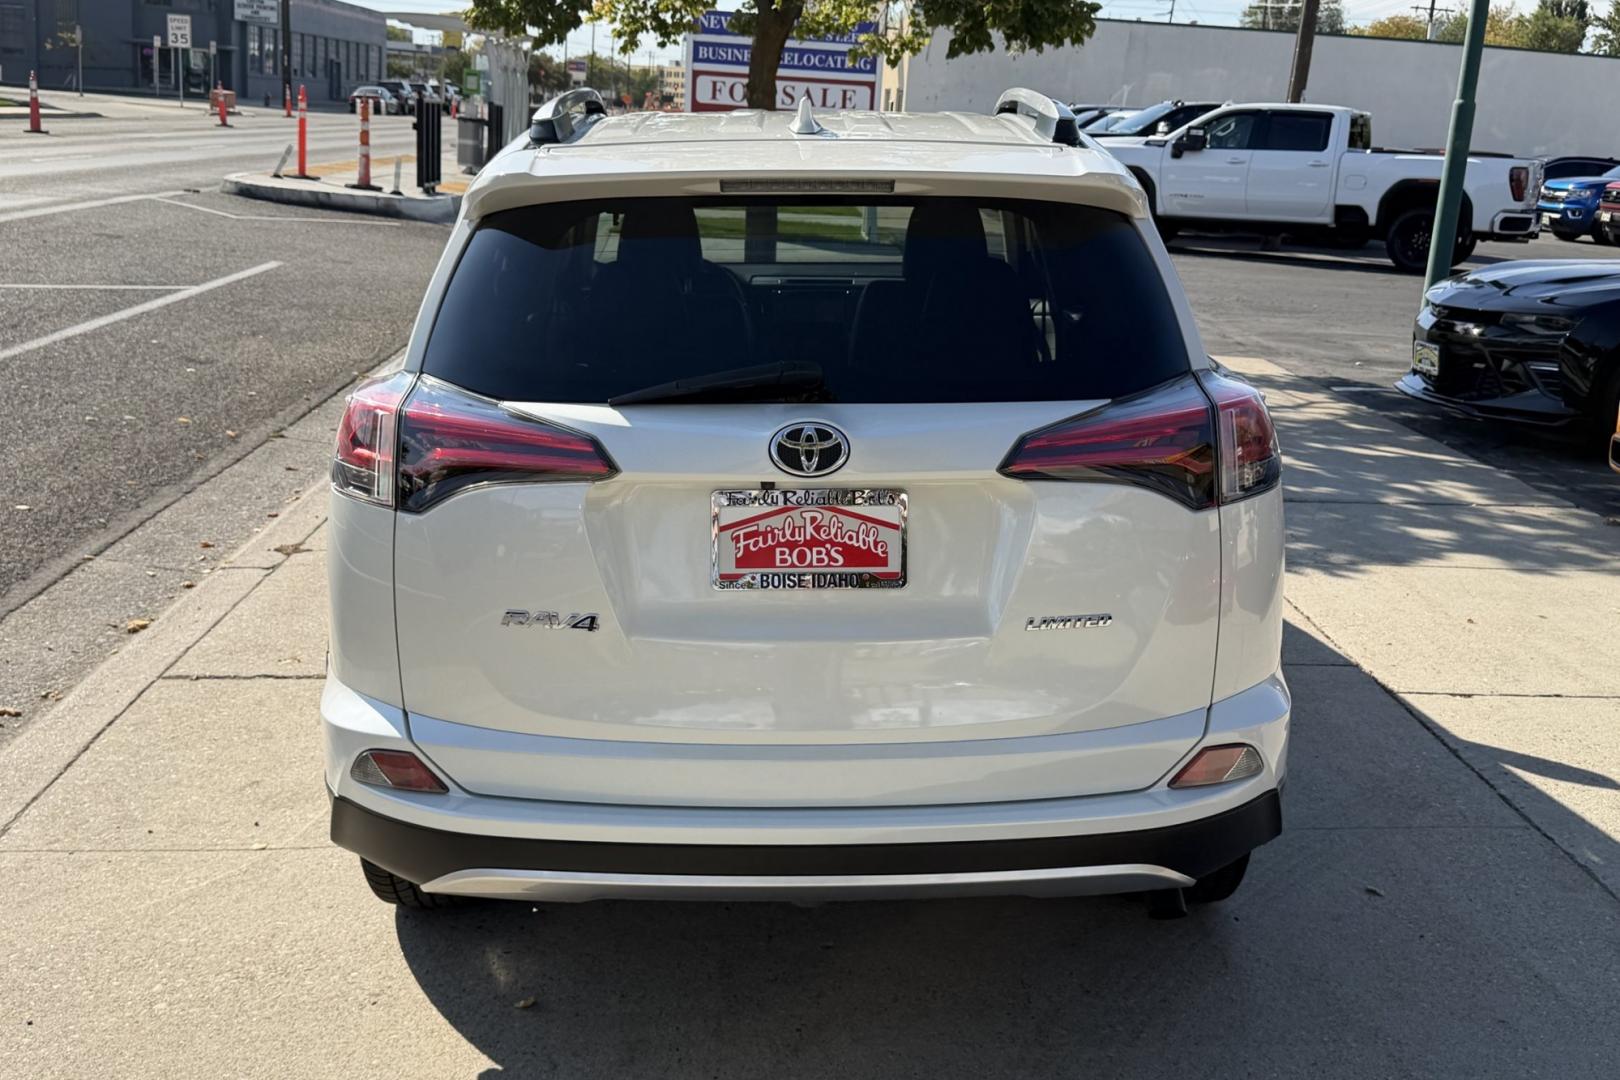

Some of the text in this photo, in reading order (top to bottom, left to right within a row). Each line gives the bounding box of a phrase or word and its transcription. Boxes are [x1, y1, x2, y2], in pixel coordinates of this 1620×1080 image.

[171, 32, 189, 44] 35
[780, 85, 857, 109] SALE
[732, 510, 888, 557] Fairly Reliable
[775, 543, 844, 567] BOB'S
[719, 581, 746, 589] Since
[760, 573, 808, 589] BOISE
[812, 573, 859, 589] IDAHO
[500, 608, 600, 632] RAV4
[1025, 613, 1112, 631] LIMITED
